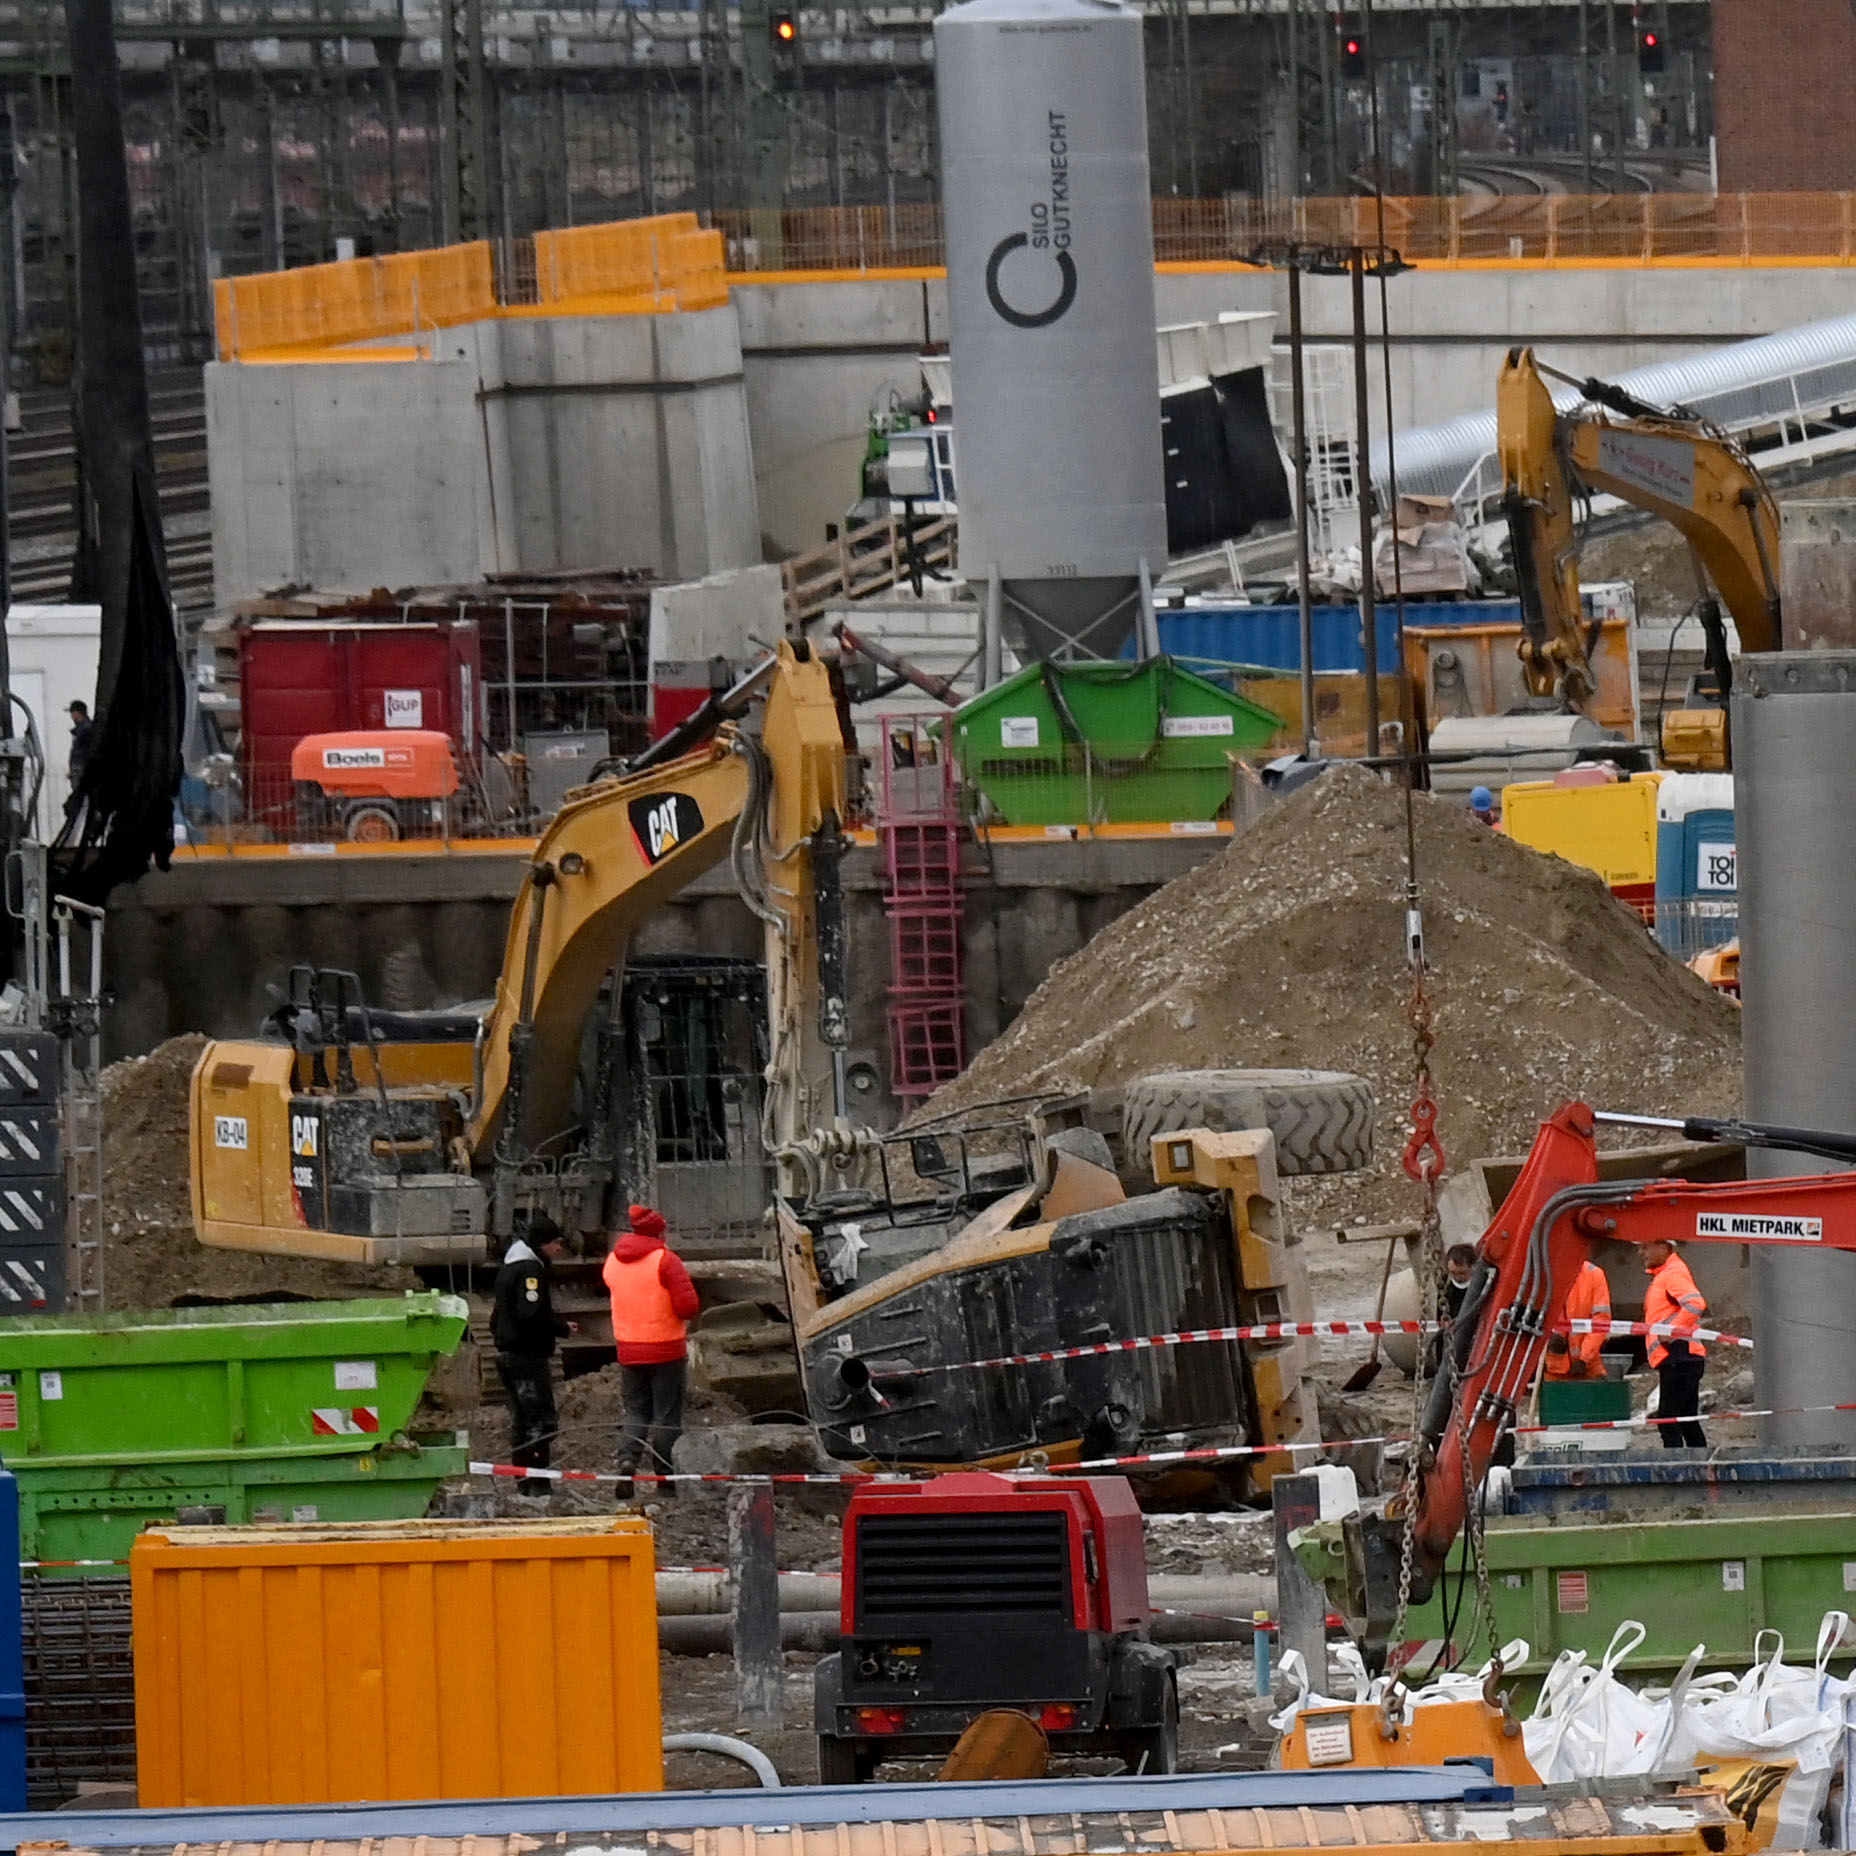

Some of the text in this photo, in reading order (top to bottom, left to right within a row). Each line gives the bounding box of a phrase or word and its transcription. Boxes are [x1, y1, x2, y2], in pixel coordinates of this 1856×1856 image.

[1049, 110, 1072, 250] GUTKNECHT
[1030, 202, 1048, 249] SILO
[326, 752, 382, 766] Boels
[646, 796, 680, 858] CAT
[1707, 856, 1735, 871] TOI
[1707, 871, 1735, 885] TOI
[216, 1120, 246, 1145] KB-04
[292, 1115, 320, 1156] CAT
[1699, 1217, 1805, 1238] HKL MIETPARK
